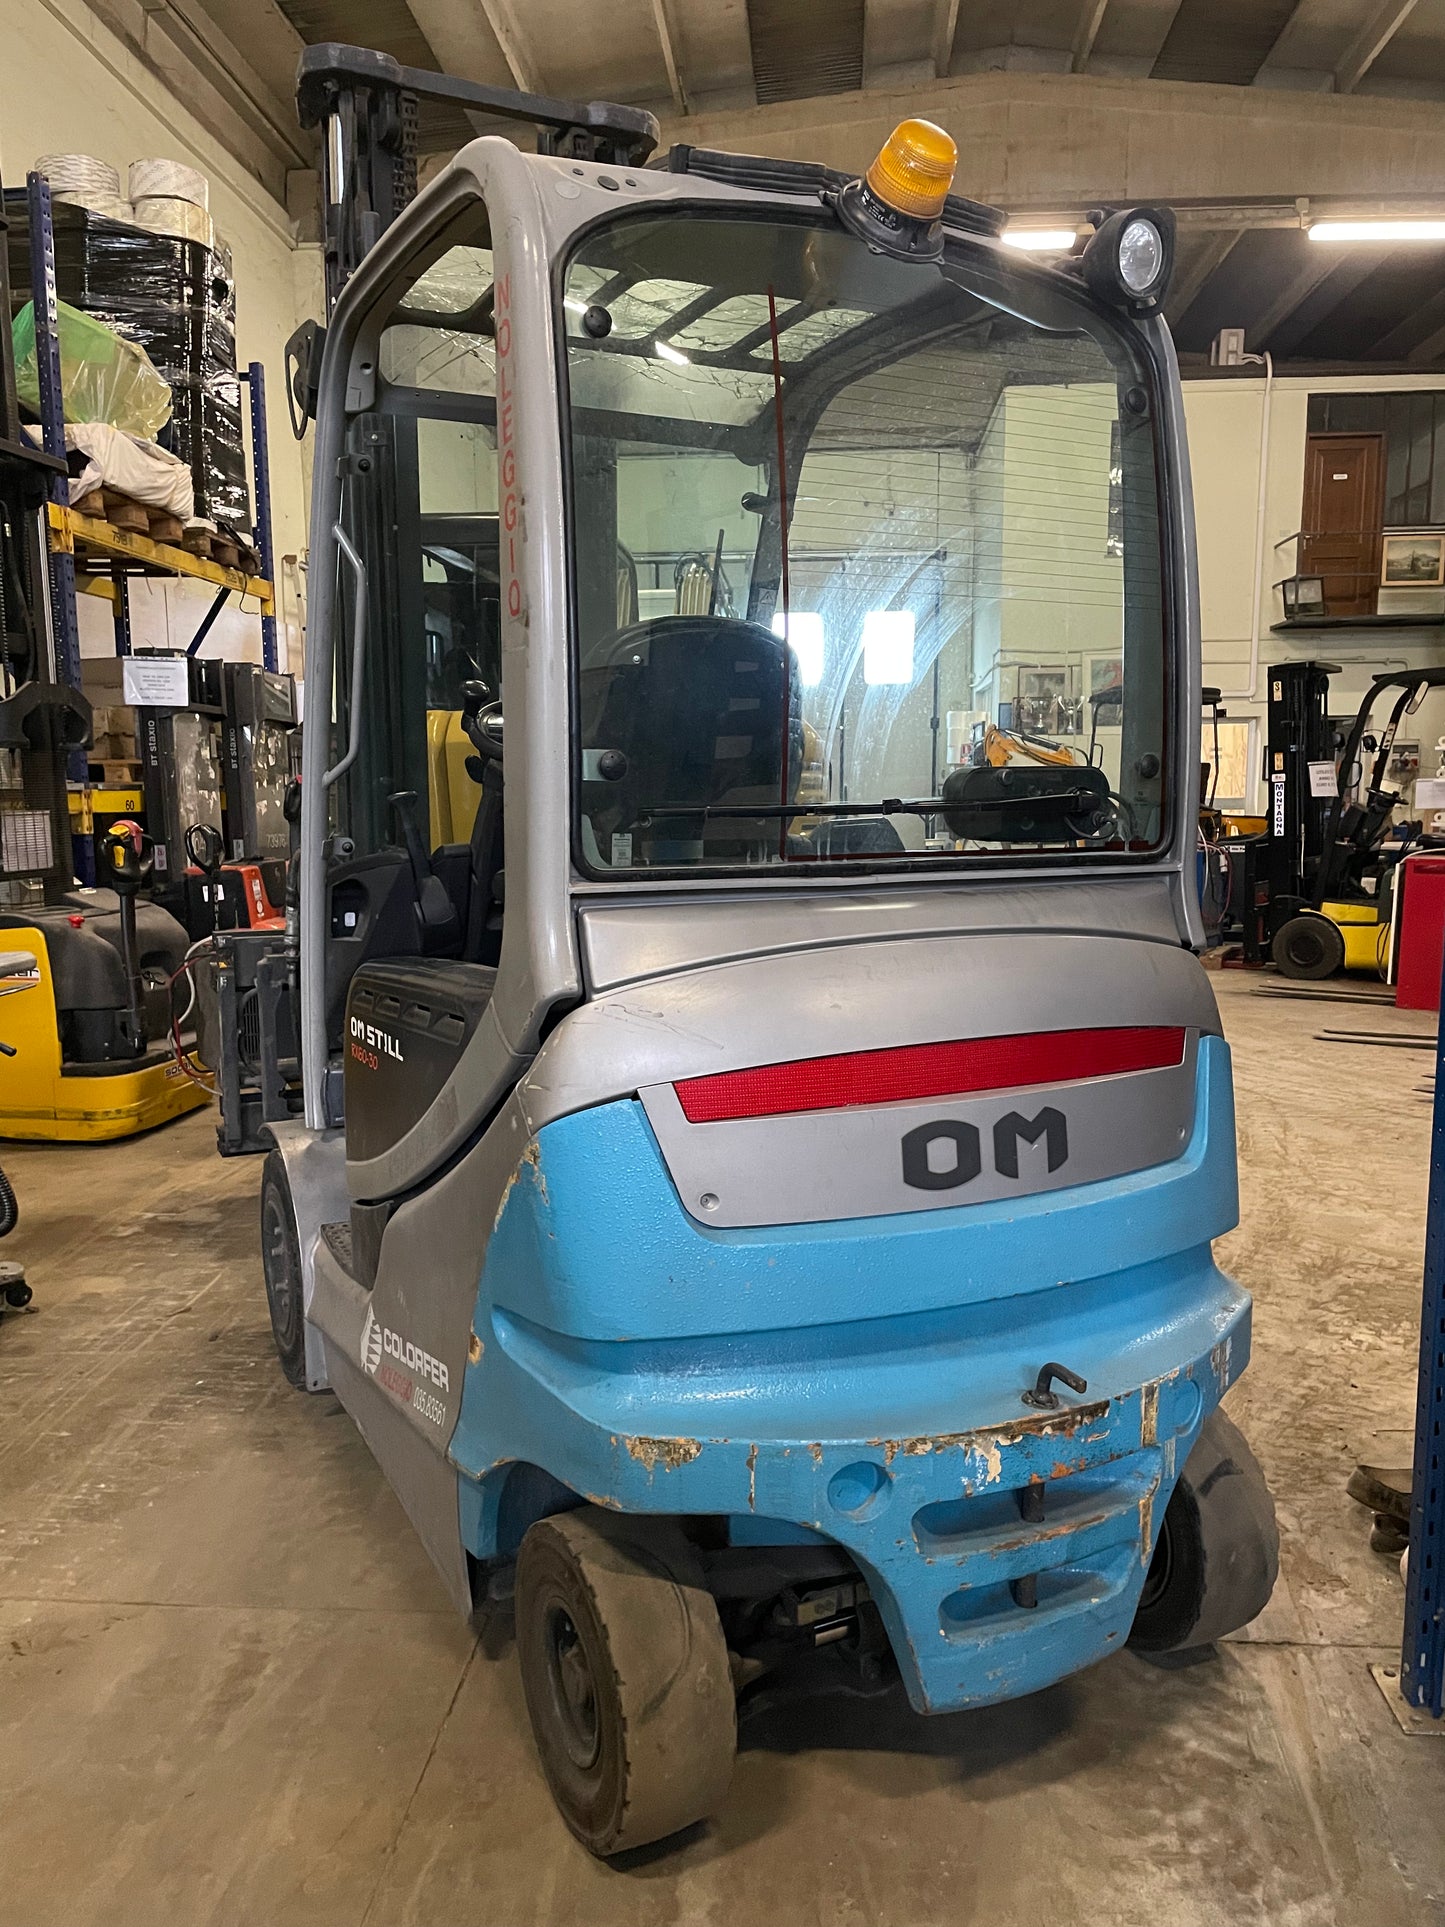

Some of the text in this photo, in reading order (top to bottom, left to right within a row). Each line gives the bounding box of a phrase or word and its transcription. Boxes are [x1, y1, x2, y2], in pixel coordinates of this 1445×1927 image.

[496, 272, 521, 618] NOLEGGIO
[150, 752, 158, 766] BT
[231, 758, 237, 769] BT
[125, 800, 135, 811] 60
[1275, 784, 1284, 835] MONTAGNA
[350, 1016, 404, 1062] OM STILL
[351, 1042, 379, 1070] RX60-30
[901, 1106, 1068, 1190] OM
[383, 1327, 450, 1393] COLORFER
